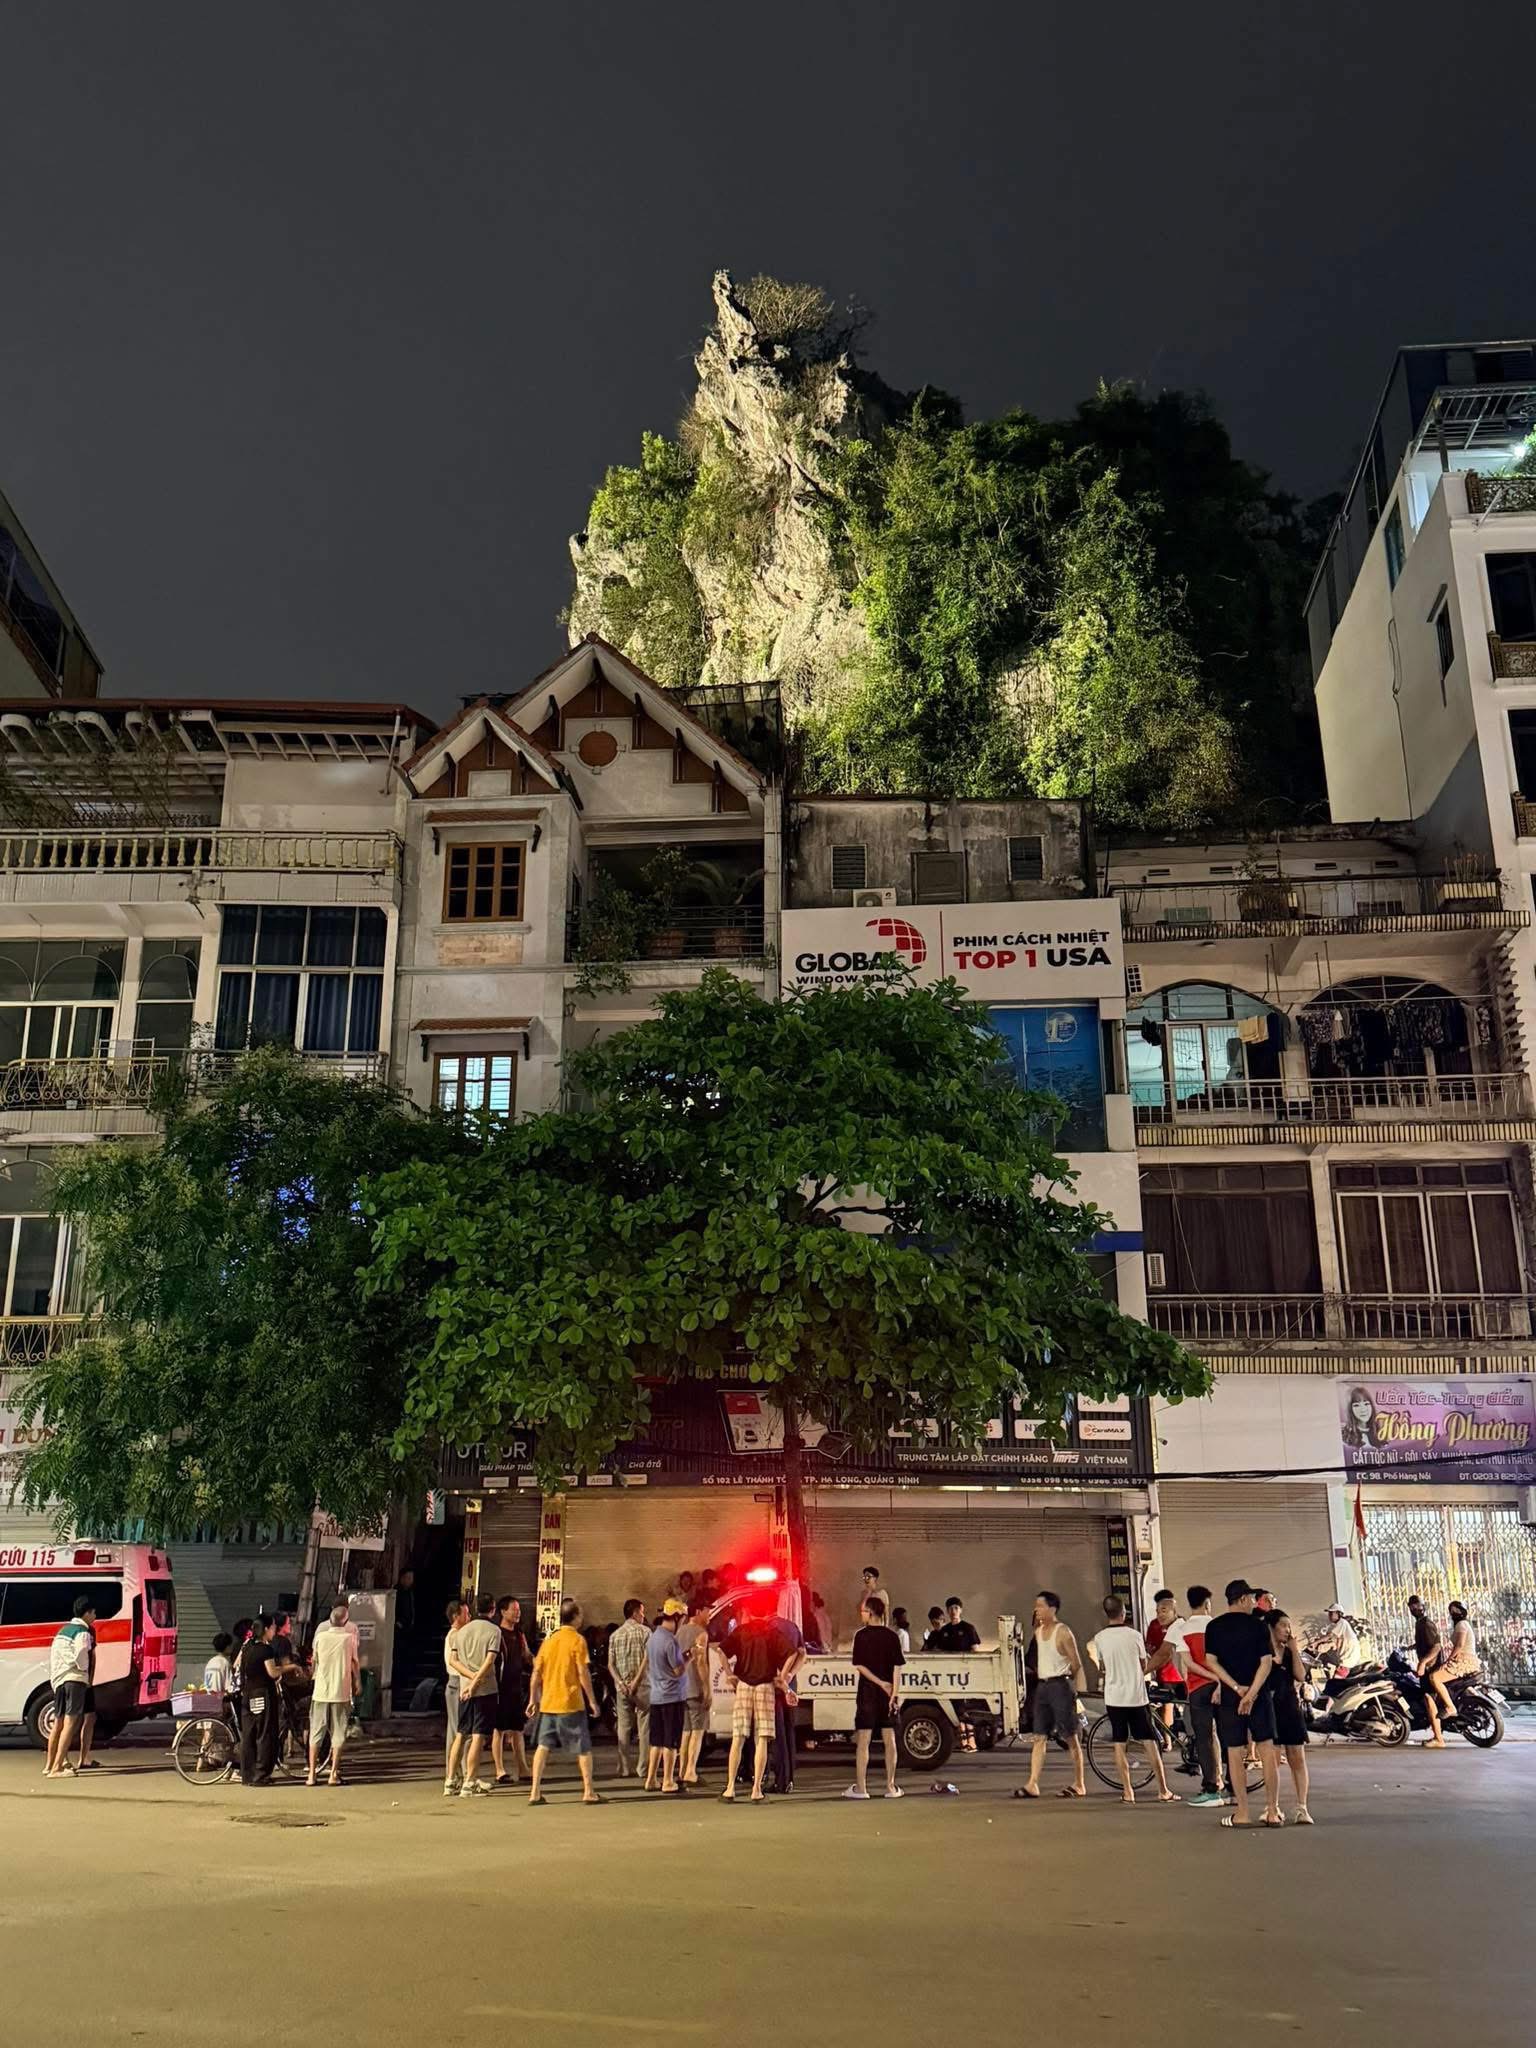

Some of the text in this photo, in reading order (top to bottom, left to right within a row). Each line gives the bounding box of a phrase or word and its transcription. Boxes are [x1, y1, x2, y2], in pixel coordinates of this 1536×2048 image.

[953, 928, 1110, 948] PHIM CÁCH NHIỆT
[953, 947, 1112, 970] TOP 1 USA
[796, 974, 859, 985] WINDOW
[1375, 1410, 1531, 1449] Hồng Phương
[628, 1460, 645, 1469] CHO
[897, 1453, 929, 1463] TRUNG
[930, 1452, 950, 1463] TÂM
[951, 1451, 969, 1463] LẮP
[971, 1453, 989, 1465] ĐẠT
[991, 1452, 1020, 1464] CHÍNH
[1021, 1453, 1049, 1464] HÃNG
[1084, 1453, 1105, 1466] VIỆT
[1106, 1455, 1128, 1465] NAM
[702, 1474, 715, 1484] SỐ
[716, 1476, 731, 1484] 102
[733, 1473, 744, 1484] LÊ
[745, 1474, 774, 1484] THÁNH
[804, 1475, 818, 1484] TP.
[821, 1475, 833, 1485] HẠ
[835, 1475, 862, 1485] LONG,
[864, 1474, 895, 1485] QUẢNG
[897, 1476, 920, 1485] NINH
[1044, 1476, 1061, 1484] 098
[1112, 1477, 1130, 1485] 204
[1399, 1472, 1417, 1482] Hàng
[0, 1545, 56, 1566] CỨU 115
[540, 1560, 561, 1580] CÁCH
[808, 1668, 970, 1690] CẢNH TRẬT TỰ
